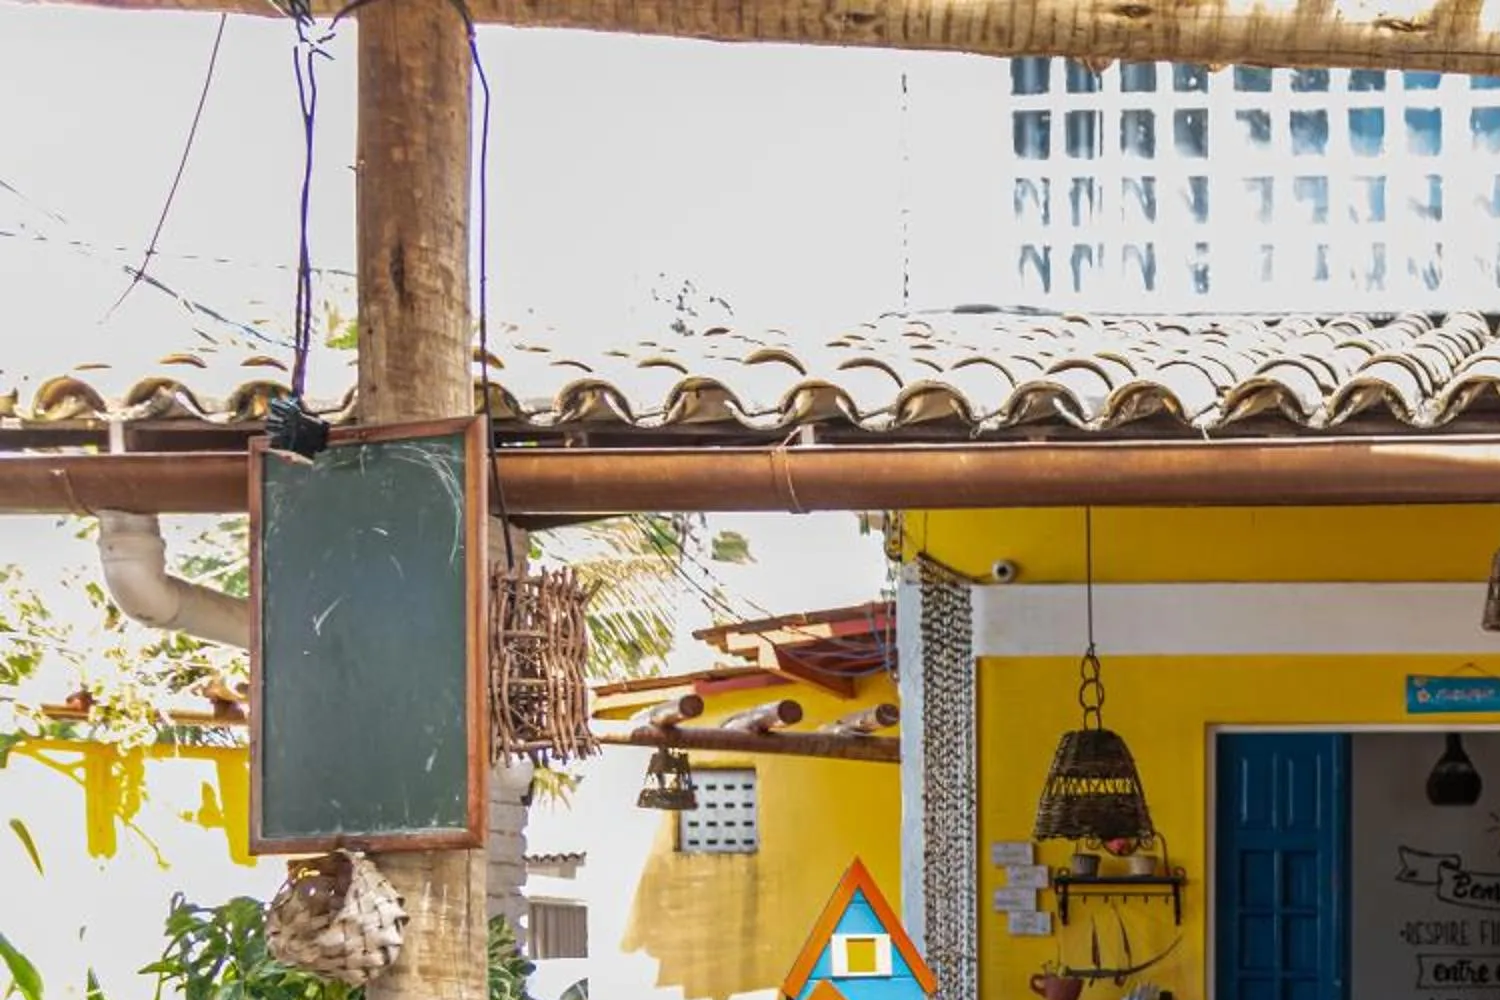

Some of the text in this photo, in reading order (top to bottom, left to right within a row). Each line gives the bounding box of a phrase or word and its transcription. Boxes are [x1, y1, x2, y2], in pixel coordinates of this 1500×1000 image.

[1453, 873, 1500, 901] Bem
[1405, 921, 1470, 946] RESPIRE
[1433, 960, 1489, 983] entre
